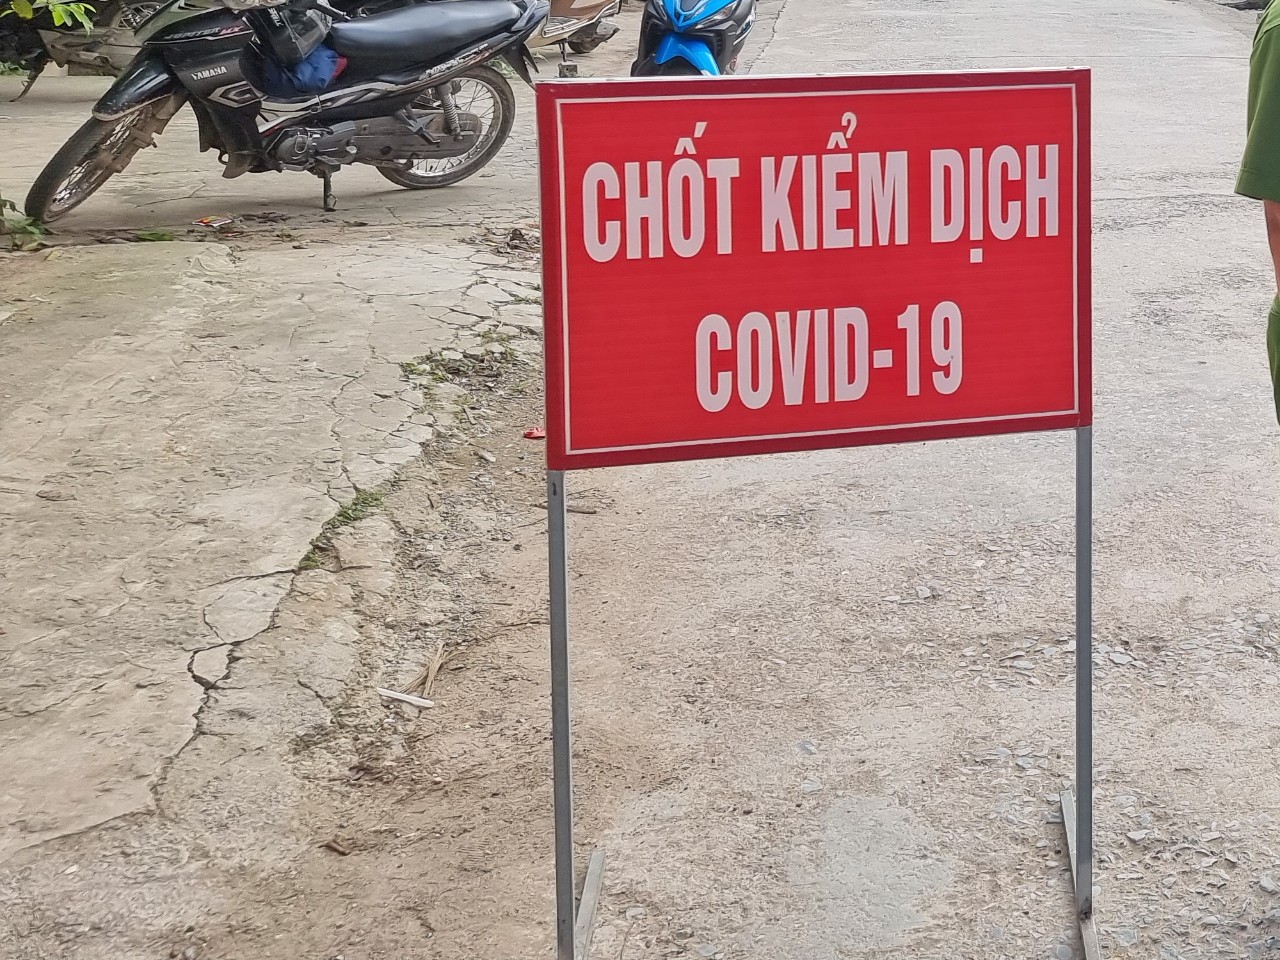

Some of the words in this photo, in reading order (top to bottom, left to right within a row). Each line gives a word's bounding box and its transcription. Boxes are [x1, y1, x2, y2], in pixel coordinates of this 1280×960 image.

[191, 66, 227, 80] YAMAHA
[581, 121, 740, 263] CHỐT
[760, 112, 909, 253] KIỂM
[929, 144, 1060, 264] DỊCH
[694, 300, 964, 413] COVID-19
